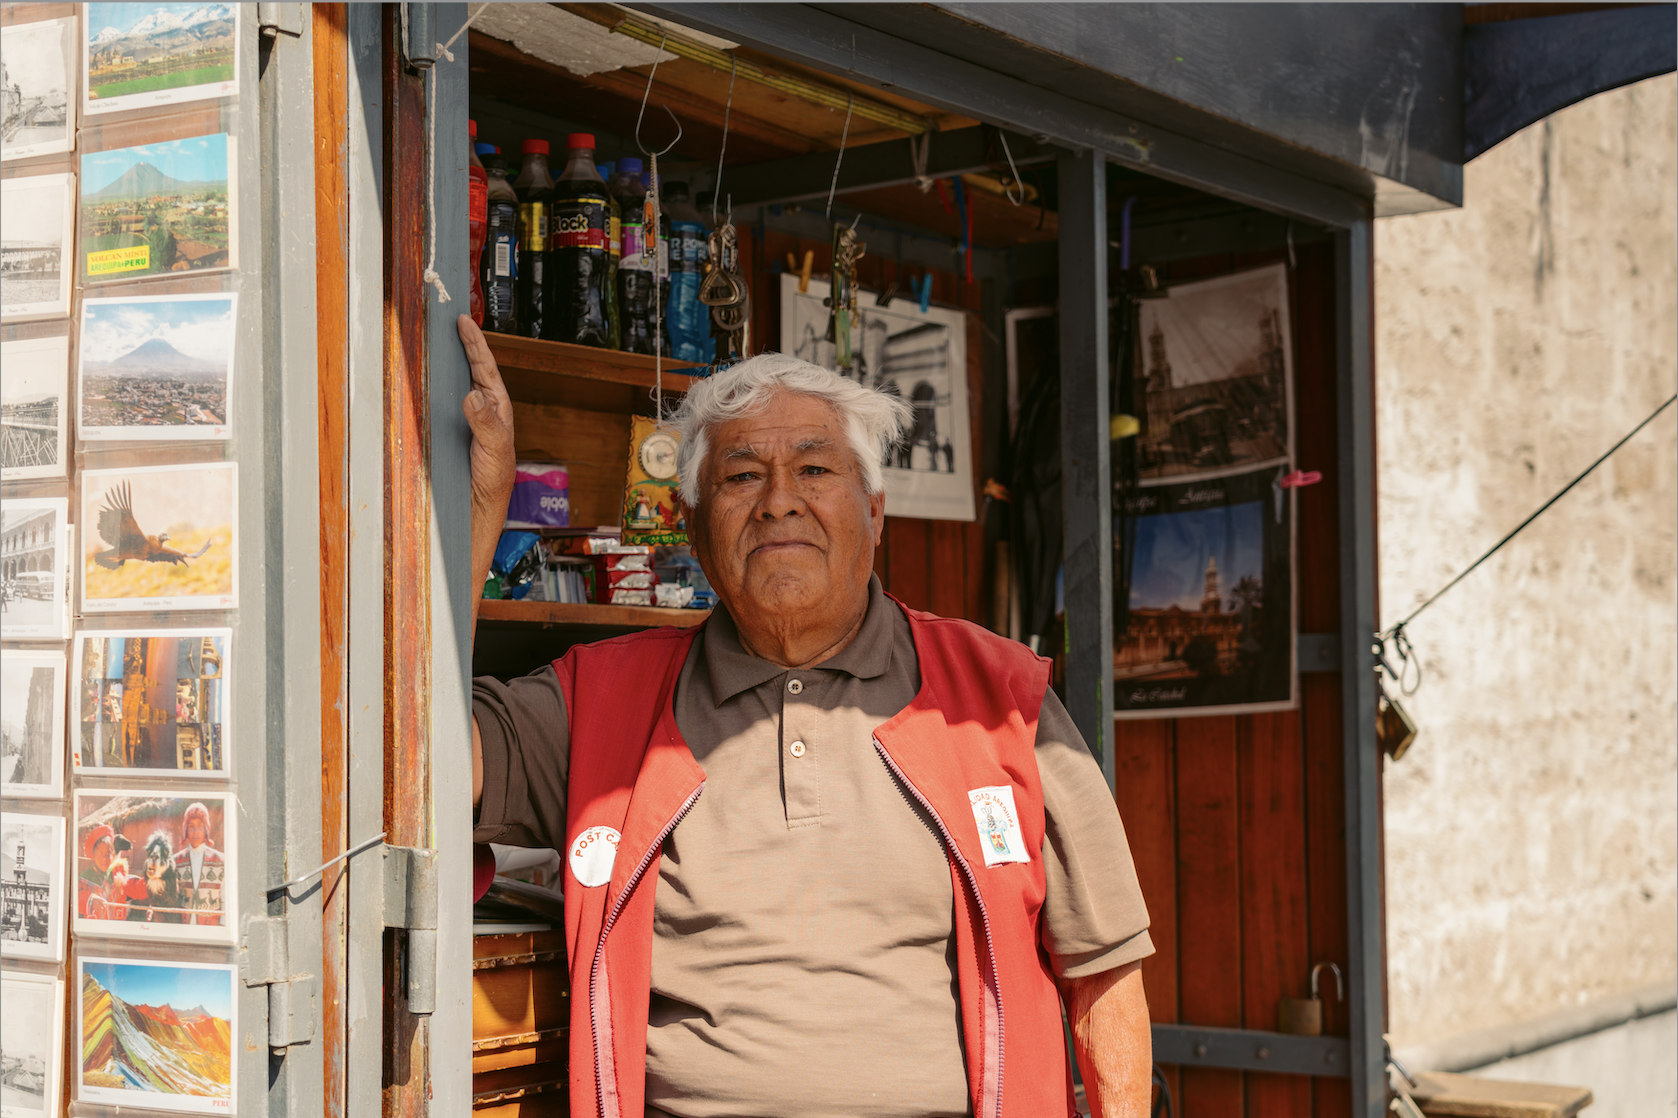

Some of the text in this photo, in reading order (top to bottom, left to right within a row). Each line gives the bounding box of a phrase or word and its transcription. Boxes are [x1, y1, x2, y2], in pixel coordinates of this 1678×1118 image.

[552, 213, 589, 235] Black
[90, 249, 147, 263] VOLCAN MISTI
[124, 257, 147, 268] PERU
[970, 793, 990, 806] LIDAD
[575, 831, 601, 857] POST
